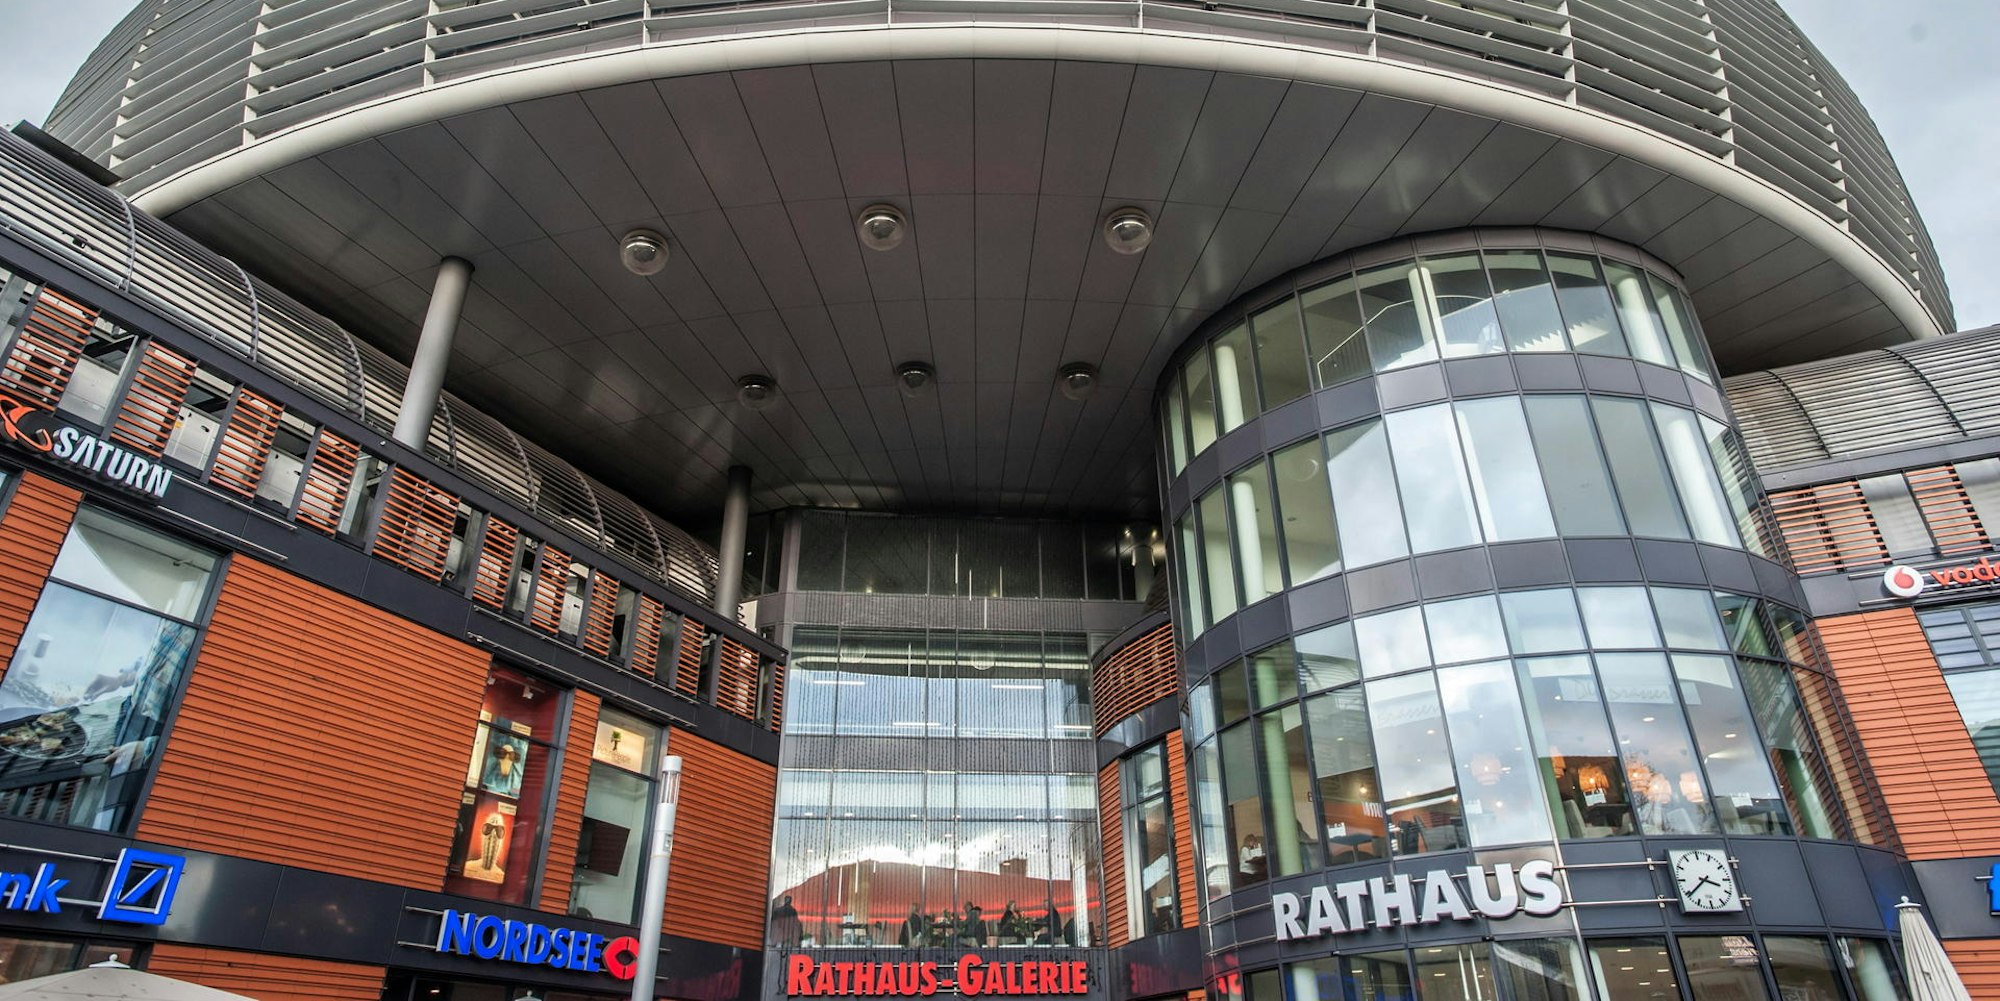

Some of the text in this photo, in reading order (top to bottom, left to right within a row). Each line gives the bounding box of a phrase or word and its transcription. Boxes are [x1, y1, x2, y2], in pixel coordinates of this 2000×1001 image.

[53, 427, 173, 498] SATURN
[1272, 860, 1563, 942] RATHAUS
[436, 909, 605, 973] NORDSEE
[787, 953, 1088, 996] RATHAUS-GALERIE
